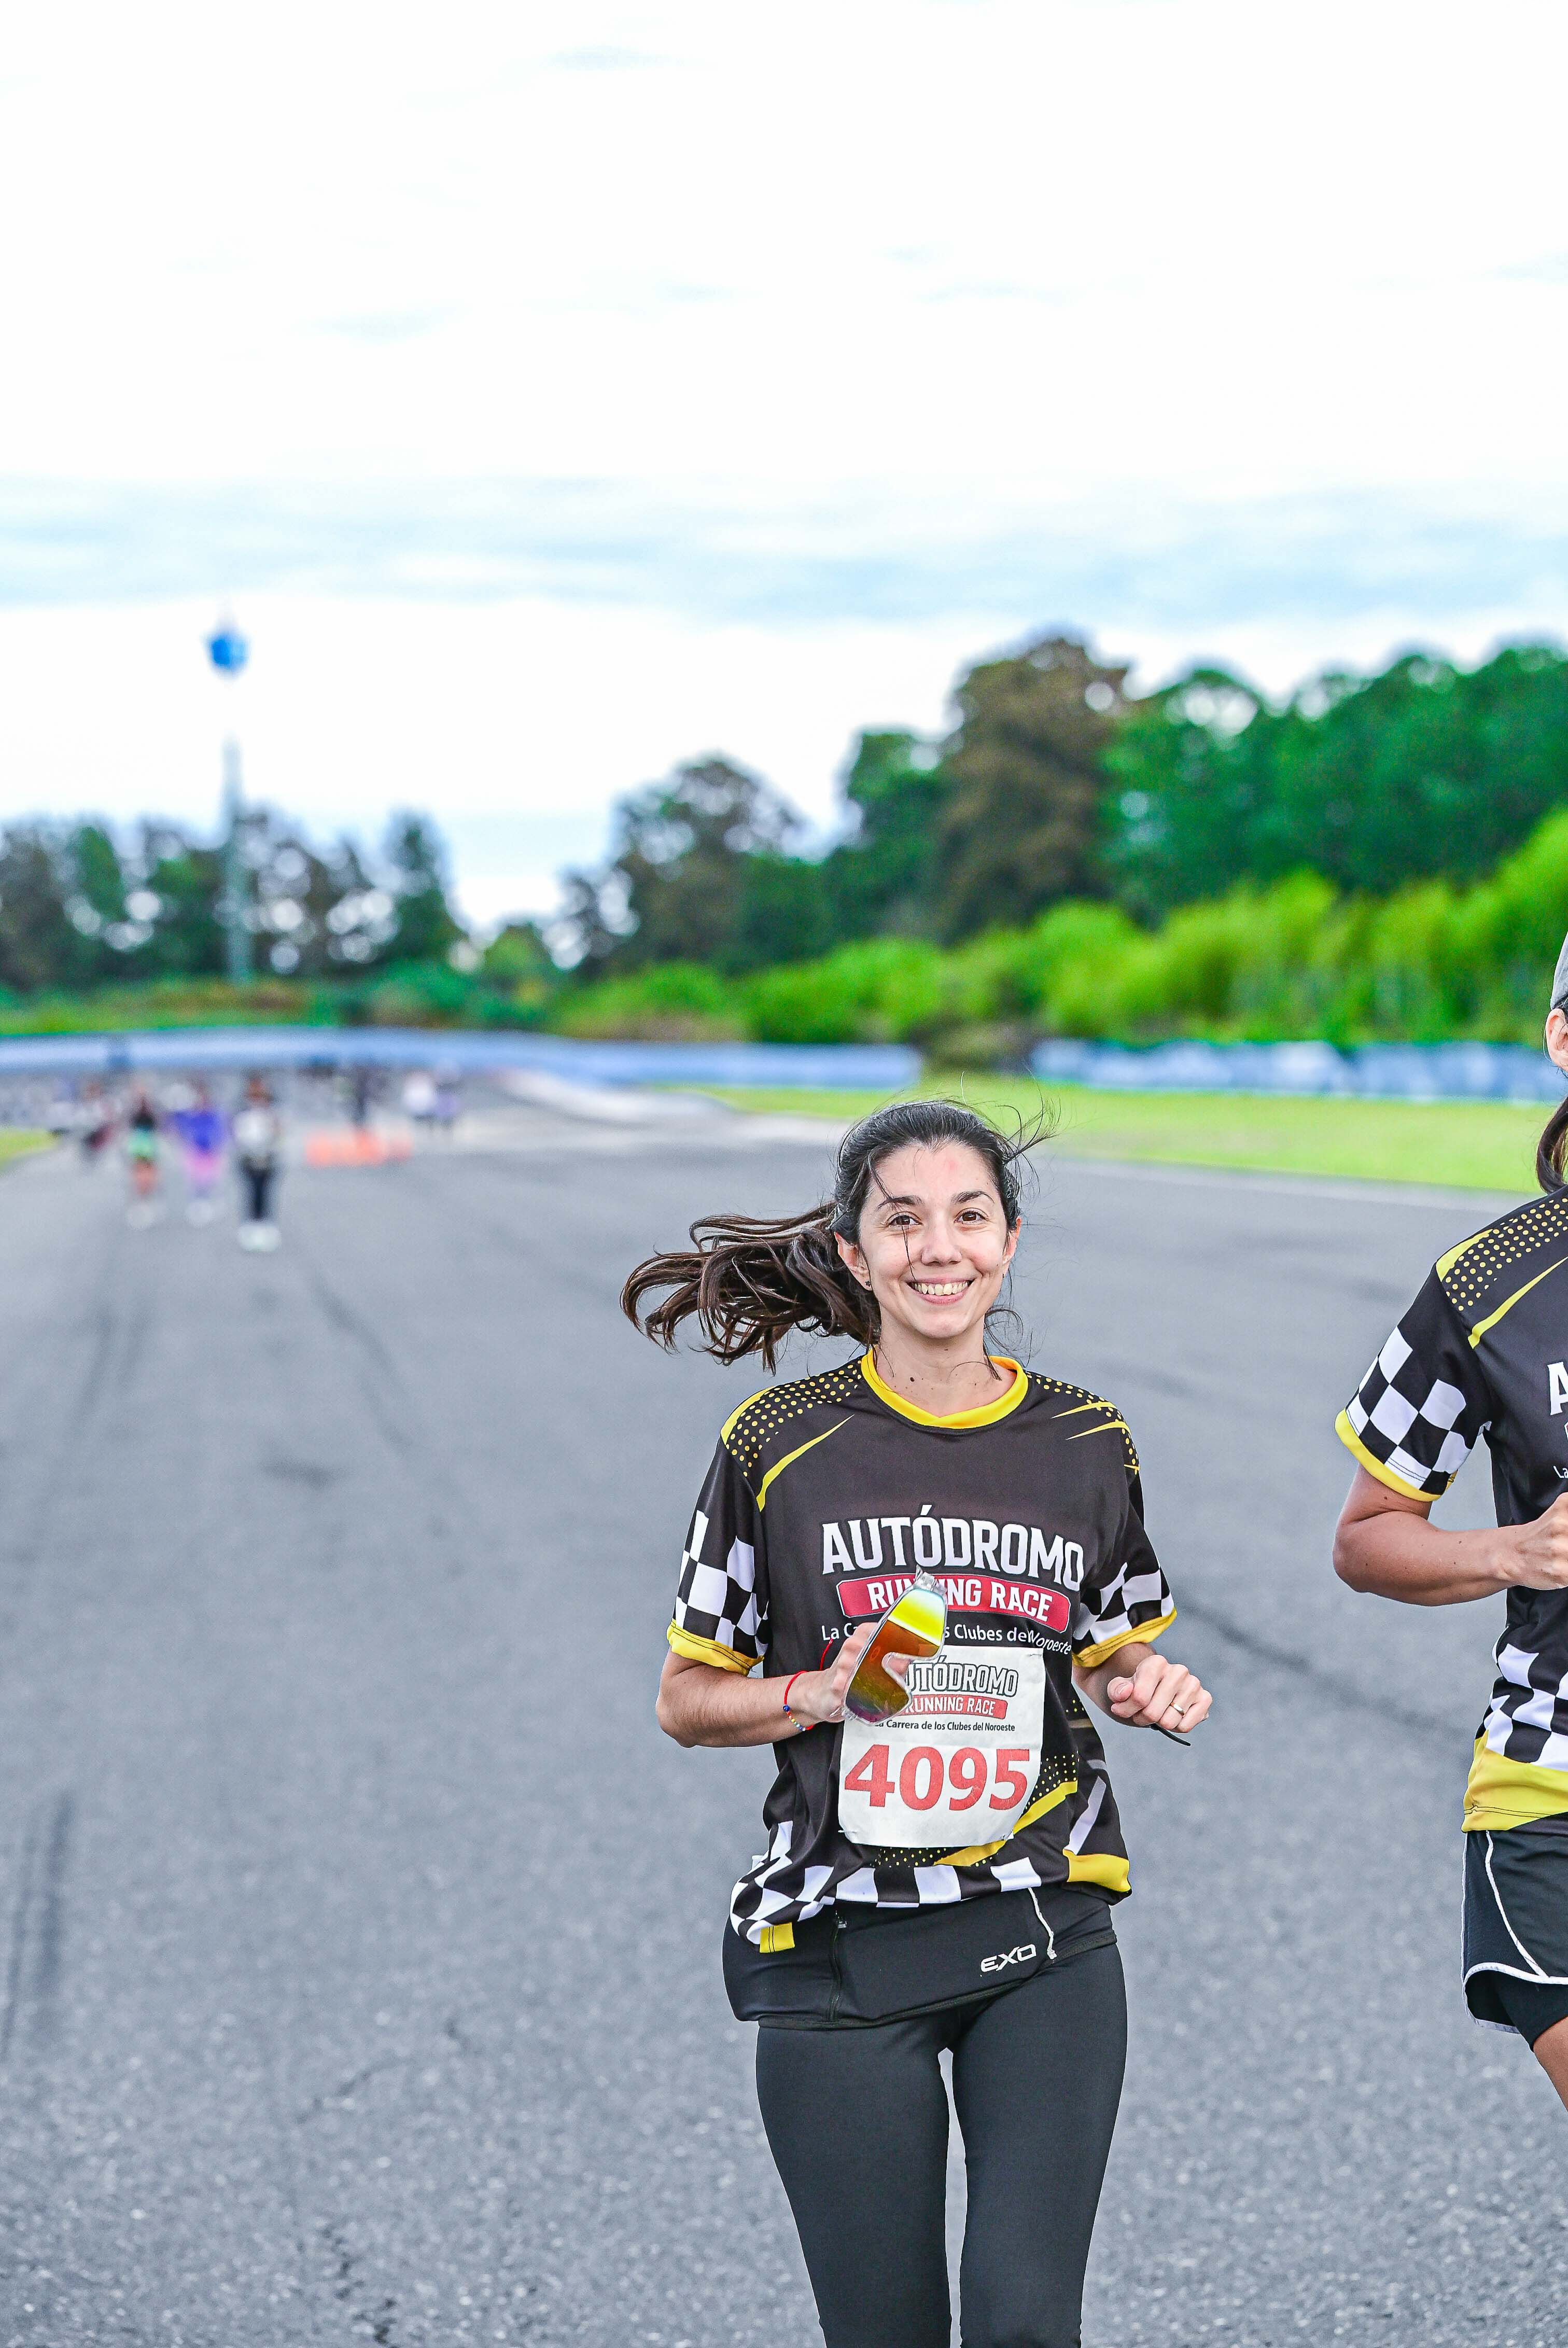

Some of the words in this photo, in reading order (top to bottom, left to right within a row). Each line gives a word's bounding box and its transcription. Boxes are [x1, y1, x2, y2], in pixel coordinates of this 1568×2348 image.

[822, 1504, 1084, 1591] AUTÓDROMO
[989, 1581, 1053, 1622] RACE
[821, 1625, 840, 1641] La
[954, 1624, 1003, 1641] Clubes
[905, 1655, 1019, 1697] UTÓDROMO
[966, 1697, 996, 1716] RACE
[886, 1720, 919, 1729] Carrera
[921, 1721, 932, 1729] de
[934, 1721, 945, 1730] los
[947, 1722, 971, 1731] Clubes
[973, 1722, 984, 1731] del
[985, 1722, 1015, 1731] Noroeste
[844, 1744, 1030, 1811] 4095
[981, 1944, 1037, 1973] EXO
